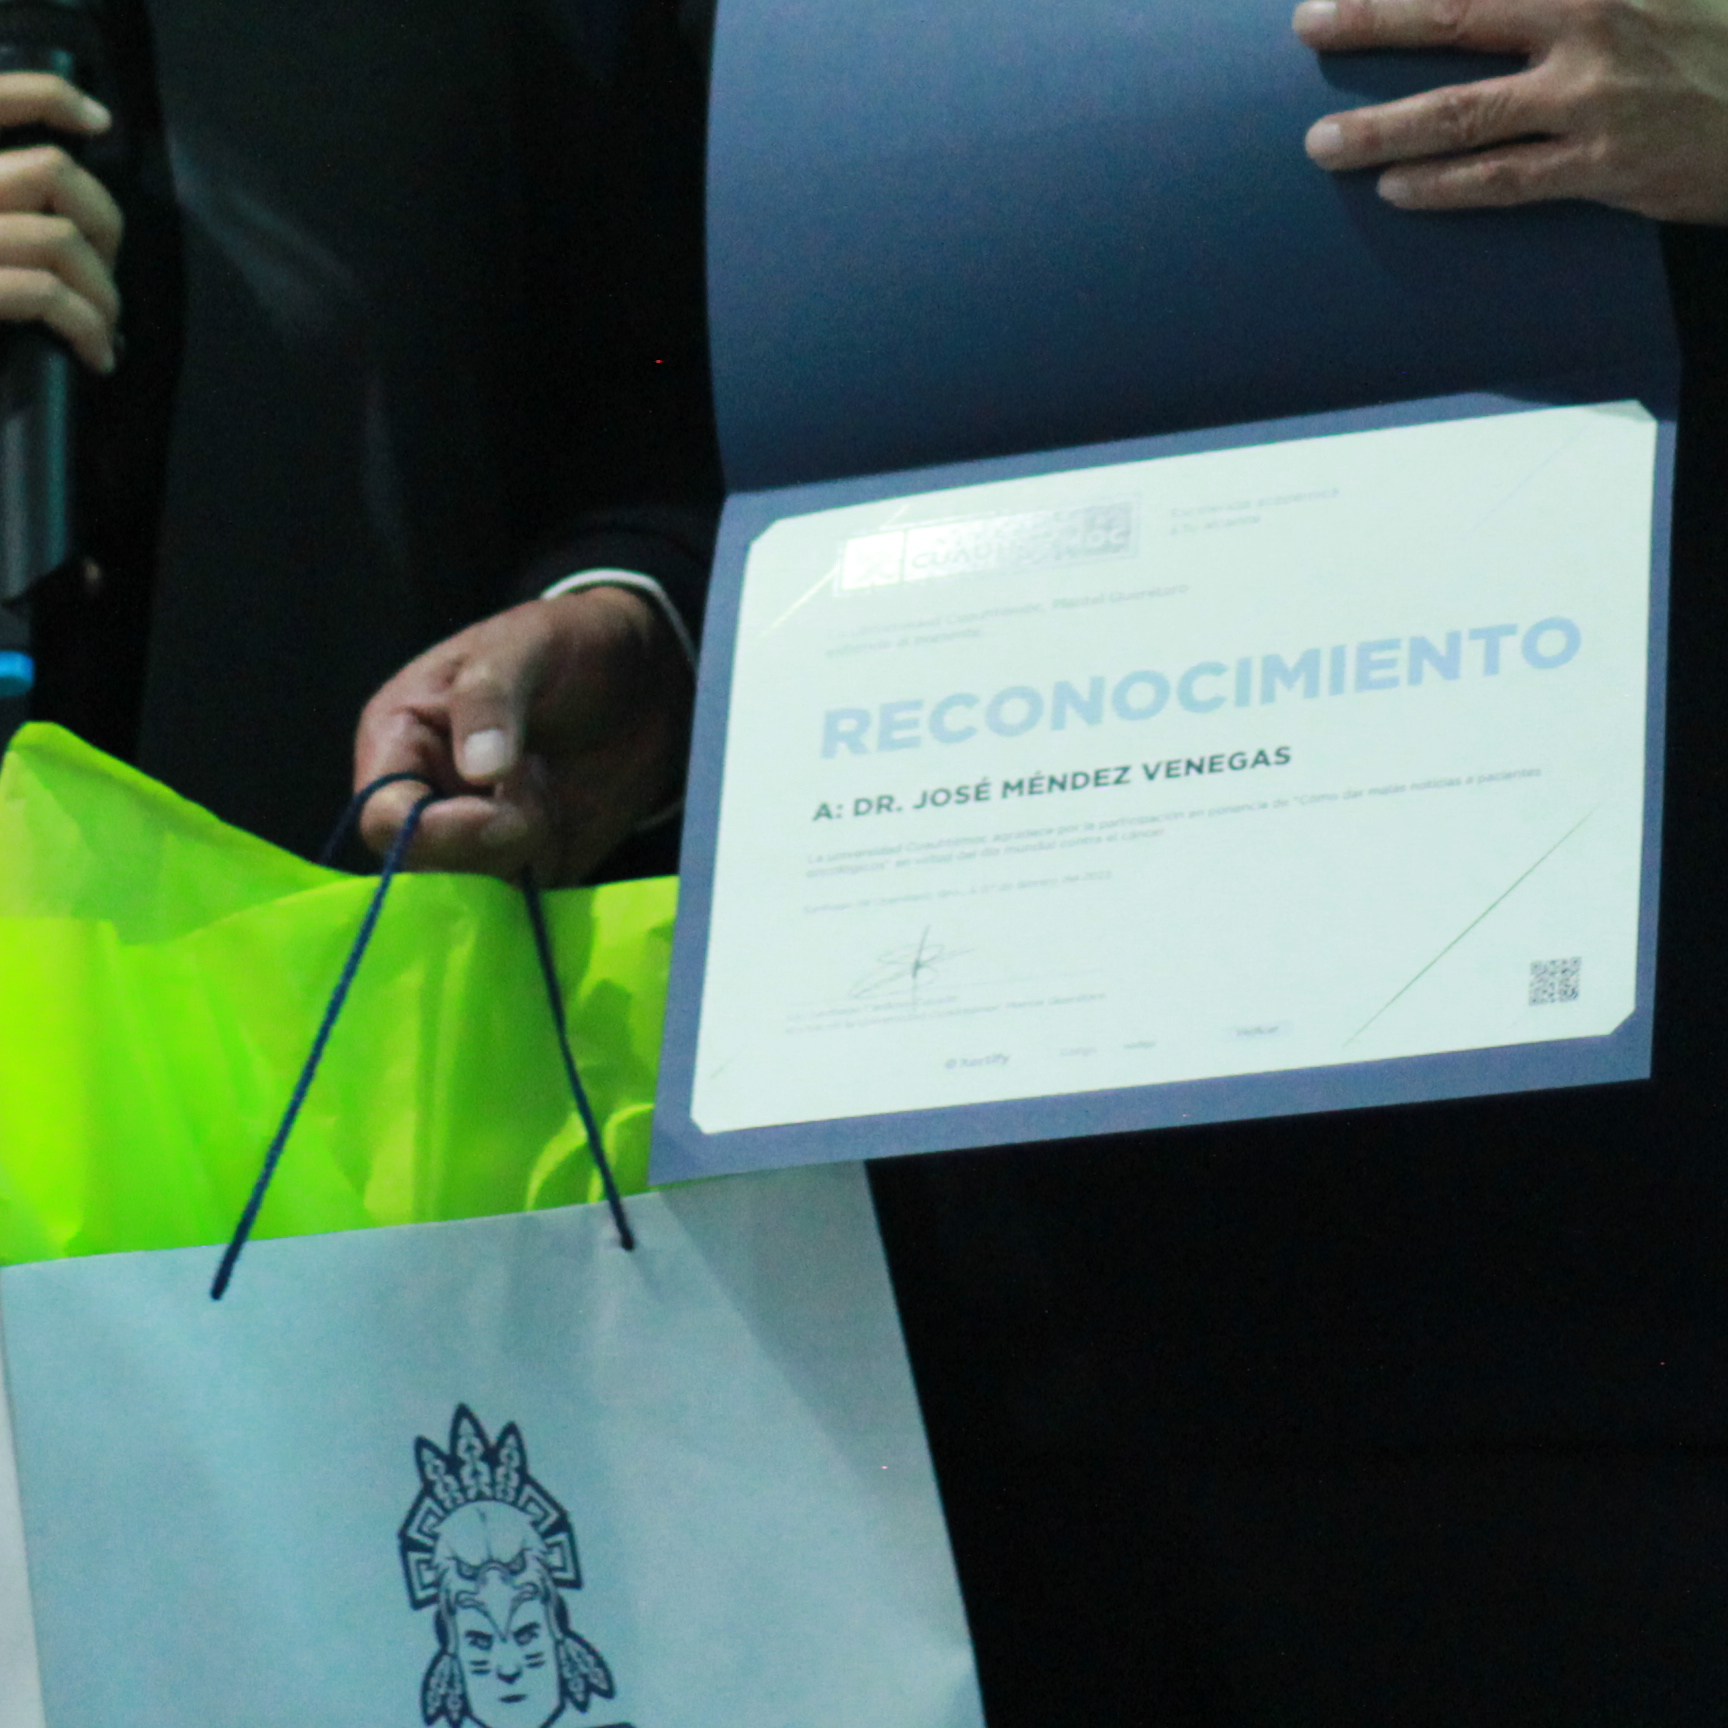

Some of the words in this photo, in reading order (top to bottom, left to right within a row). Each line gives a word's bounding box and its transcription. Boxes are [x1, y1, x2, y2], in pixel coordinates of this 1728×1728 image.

[820, 695, 1581, 760] RECONOCIMIENTO
[812, 800, 844, 822] A:
[853, 792, 903, 817] DR.
[912, 775, 992, 810] JOSÉ
[1001, 764, 1131, 800] MÉNDEZ
[1141, 745, 1292, 782] VENEGAS
